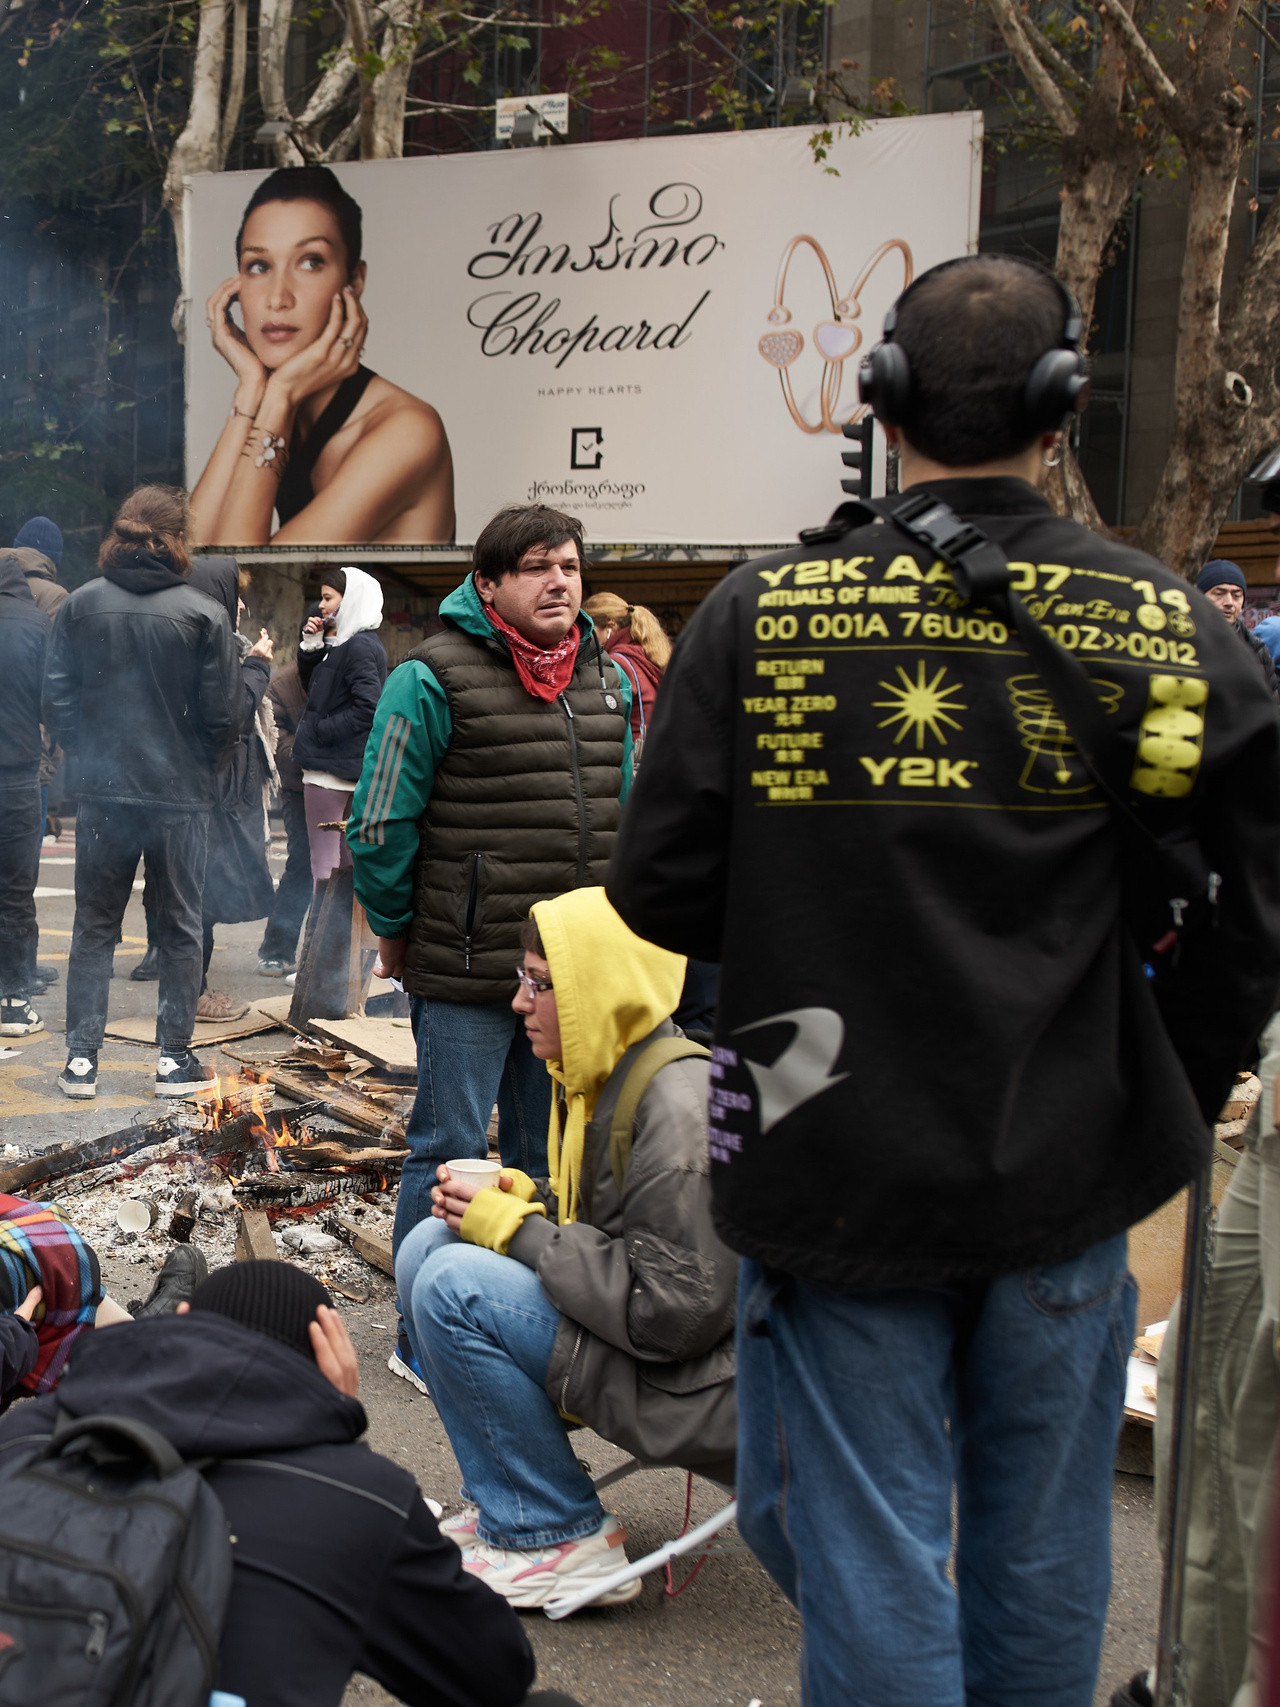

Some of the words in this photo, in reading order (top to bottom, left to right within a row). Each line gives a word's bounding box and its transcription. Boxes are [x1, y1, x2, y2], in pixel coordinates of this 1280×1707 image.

[467, 289, 712, 369] Chopard
[537, 386, 583, 397] HAPPY
[588, 384, 642, 395] HEARTS
[527, 479, 645, 501] ქრონოგრაფი
[757, 556, 874, 588] Y2K
[757, 587, 835, 608] RITUALS
[837, 586, 866, 605] OF
[867, 585, 921, 605] MINE
[756, 659, 825, 676] RETURN
[742, 696, 787, 713] YEAR
[790, 695, 837, 712] ZERO
[756, 732, 824, 750] FUTURE
[751, 770, 792, 787] NEW
[794, 769, 830, 786] ERA
[858, 756, 979, 789] Y2K
